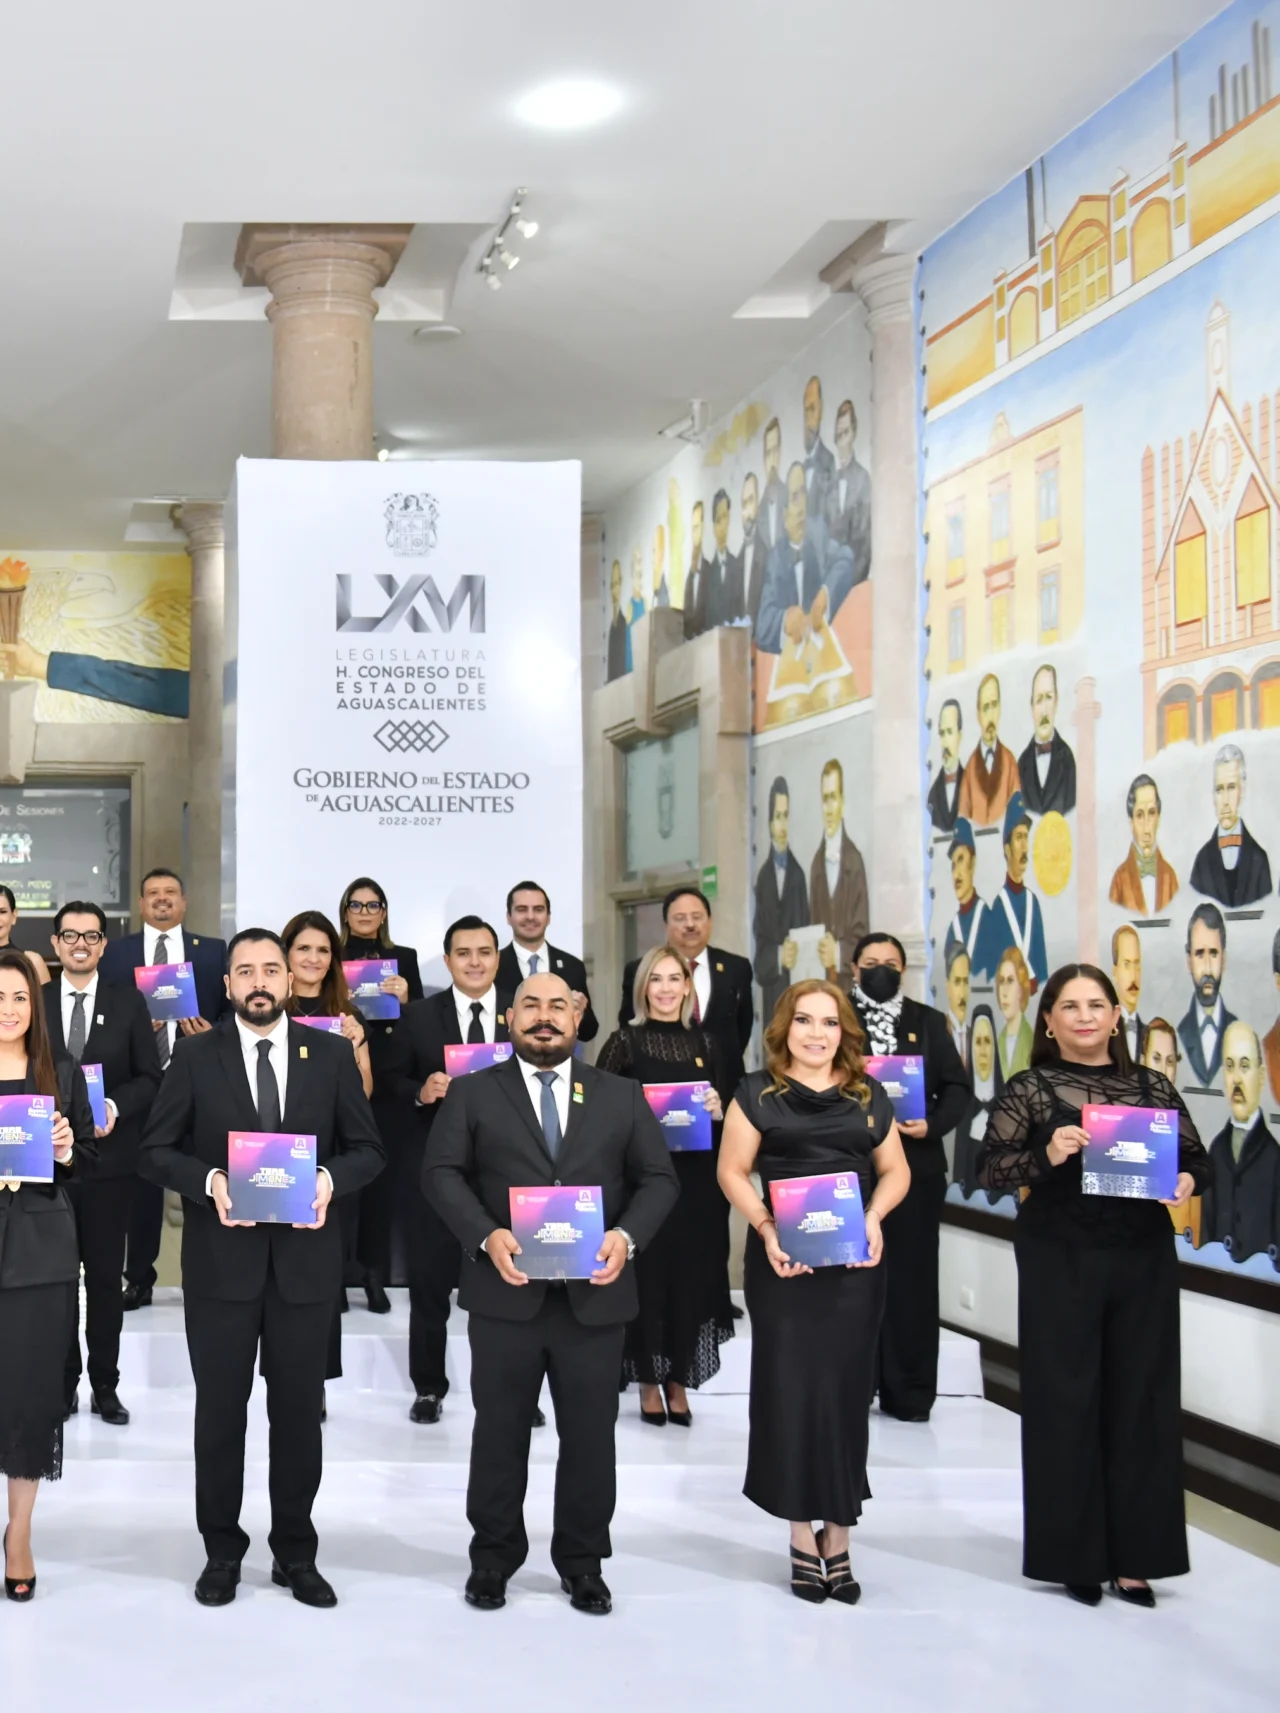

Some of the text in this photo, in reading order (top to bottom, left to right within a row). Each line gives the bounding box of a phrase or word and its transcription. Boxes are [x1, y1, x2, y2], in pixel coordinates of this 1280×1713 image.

[336, 648, 486, 662] LEGISLATURA
[336, 665, 485, 680] H. CONGRESO DEL
[336, 681, 486, 695] ESTADO DE
[336, 697, 487, 711] AGUASCALIENTES
[293, 768, 530, 790] GOBIERNO DEL ESTADO
[306, 794, 515, 814] DE AGUASCALIENTES
[378, 817, 442, 827] 2022-2027
